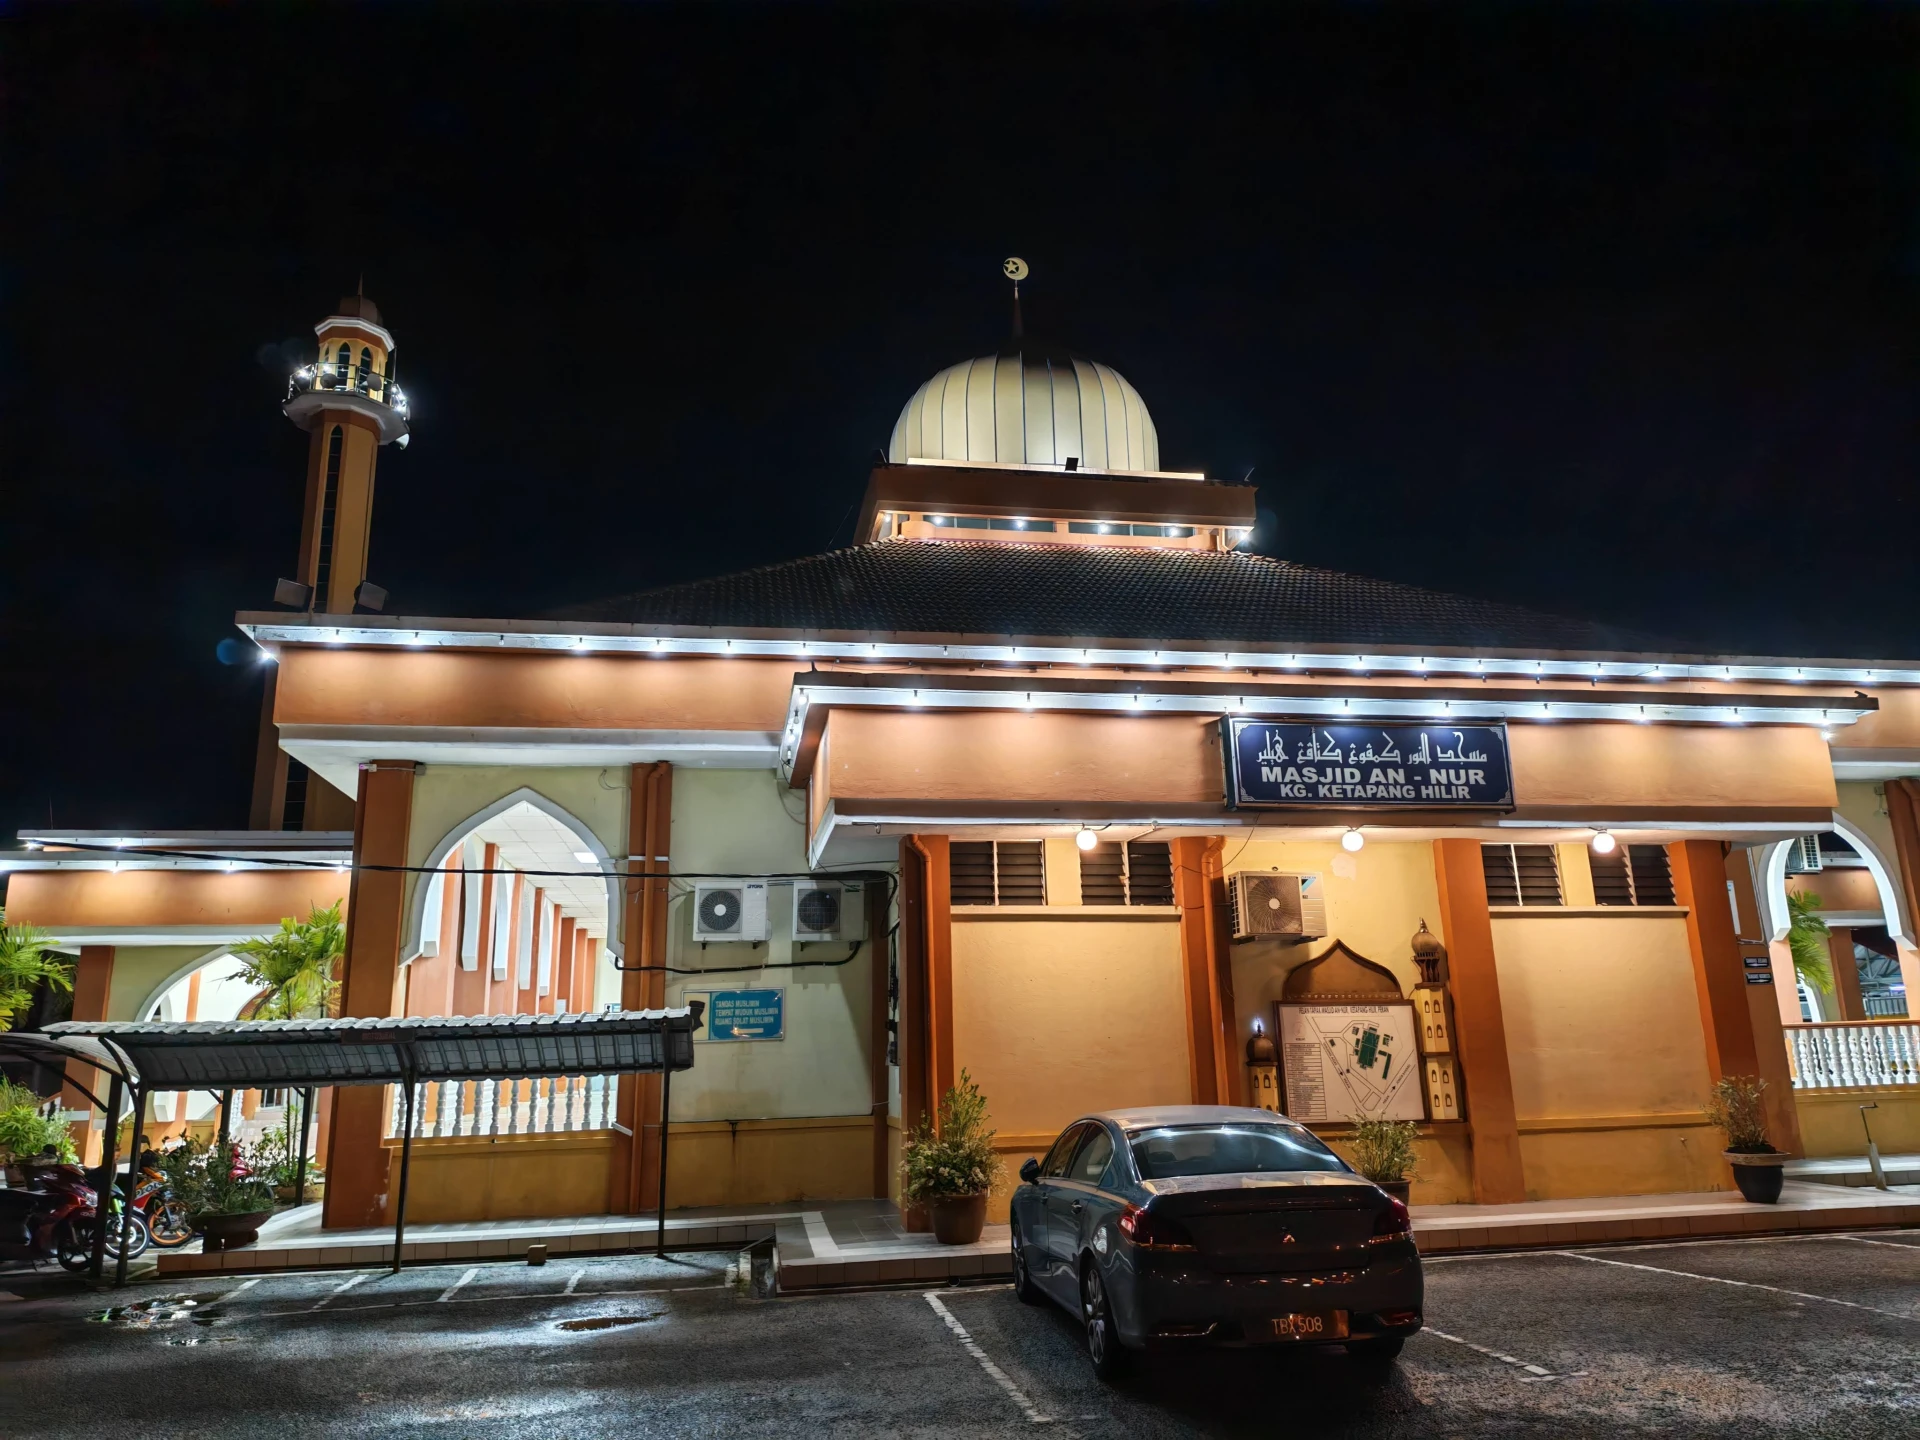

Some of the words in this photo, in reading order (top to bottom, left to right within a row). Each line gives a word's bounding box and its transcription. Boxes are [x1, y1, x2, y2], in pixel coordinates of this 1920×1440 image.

[1407, 732, 1432, 765] النور
[1436, 731, 1488, 765] مسجد
[1261, 766, 1365, 784] MASJID
[1369, 768, 1406, 784] AN
[1430, 769, 1486, 785] NUR
[1280, 784, 1313, 798] KG.
[1318, 784, 1415, 799] KETAPANG
[1421, 785, 1471, 799] HILIR
[1272, 1318, 1297, 1335] TBX
[1298, 1316, 1323, 1333] 508
